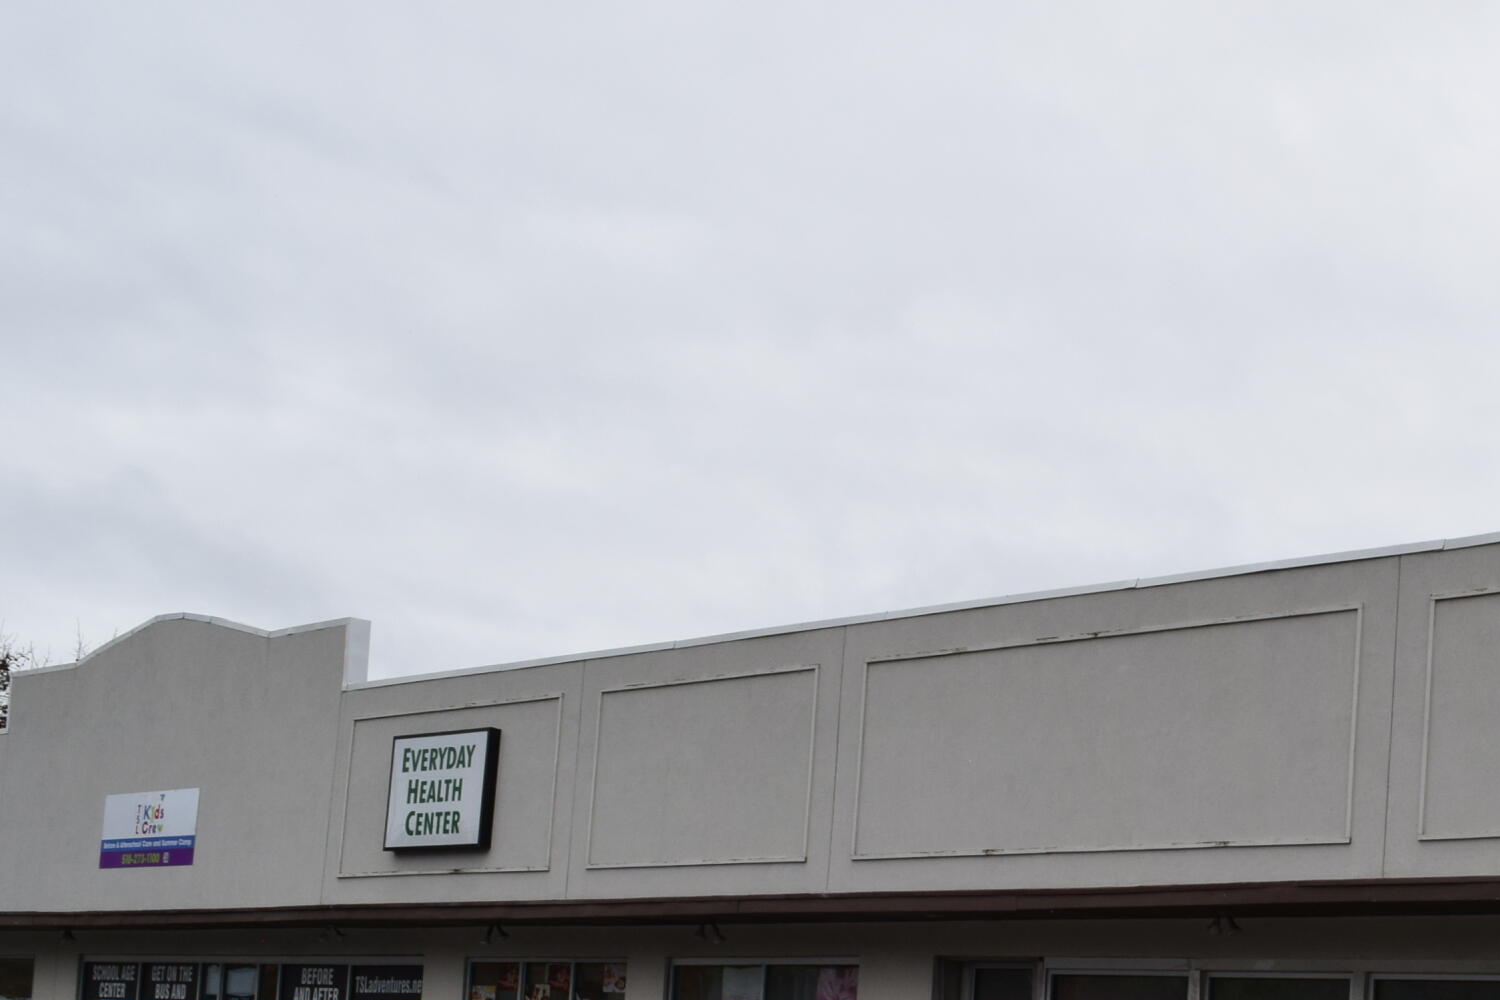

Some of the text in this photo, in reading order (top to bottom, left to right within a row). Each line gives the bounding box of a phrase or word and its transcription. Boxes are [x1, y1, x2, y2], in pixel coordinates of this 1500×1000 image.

[402, 744, 476, 774] EVERYDAY
[407, 778, 464, 805] HEALTH
[143, 803, 165, 820] Kids
[141, 821, 164, 835] Crew
[405, 810, 461, 837] CENTER
[93, 964, 135, 980] SCHOOL AGE
[151, 965, 193, 982] GET ON THE
[301, 967, 335, 985] BEFORE
[98, 982, 126, 998] CENTER
[154, 983, 187, 1000] BUS AND
